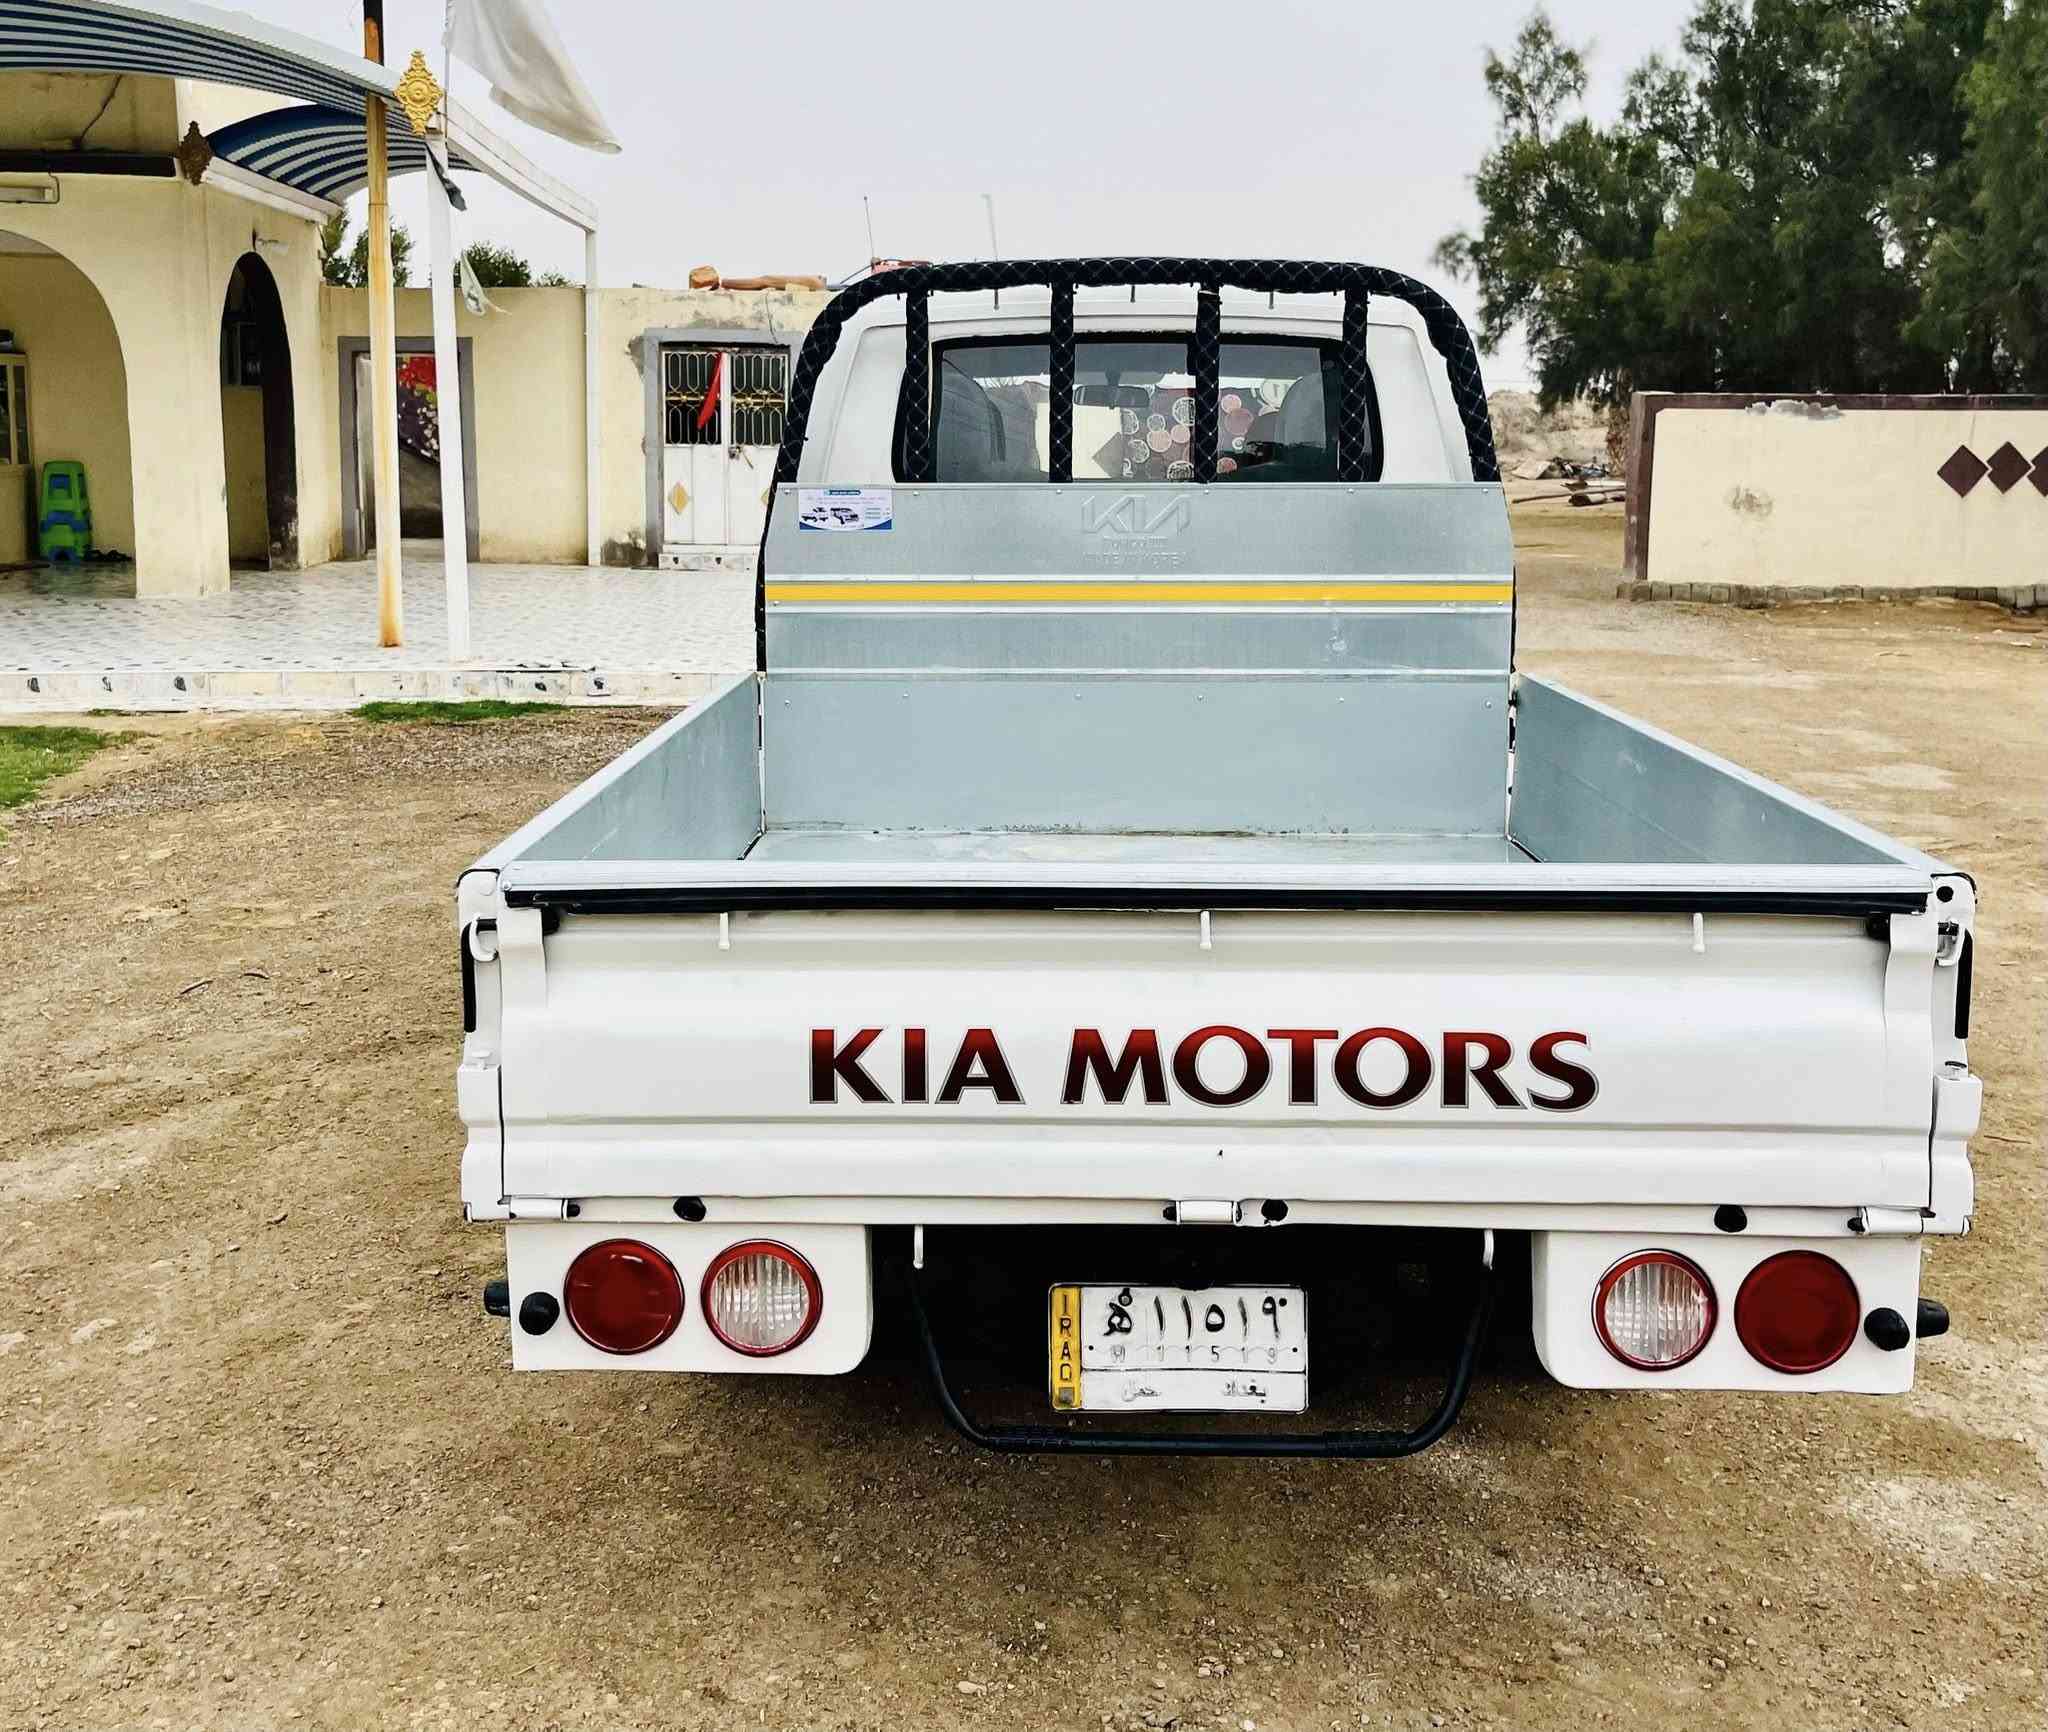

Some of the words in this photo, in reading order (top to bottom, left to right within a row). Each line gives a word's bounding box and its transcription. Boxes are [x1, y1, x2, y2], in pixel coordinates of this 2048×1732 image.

[808, 1026, 1027, 1106] KIA
[1059, 1024, 1600, 1112] MOTORS
[1060, 1293, 1074, 1382] IRAQ
